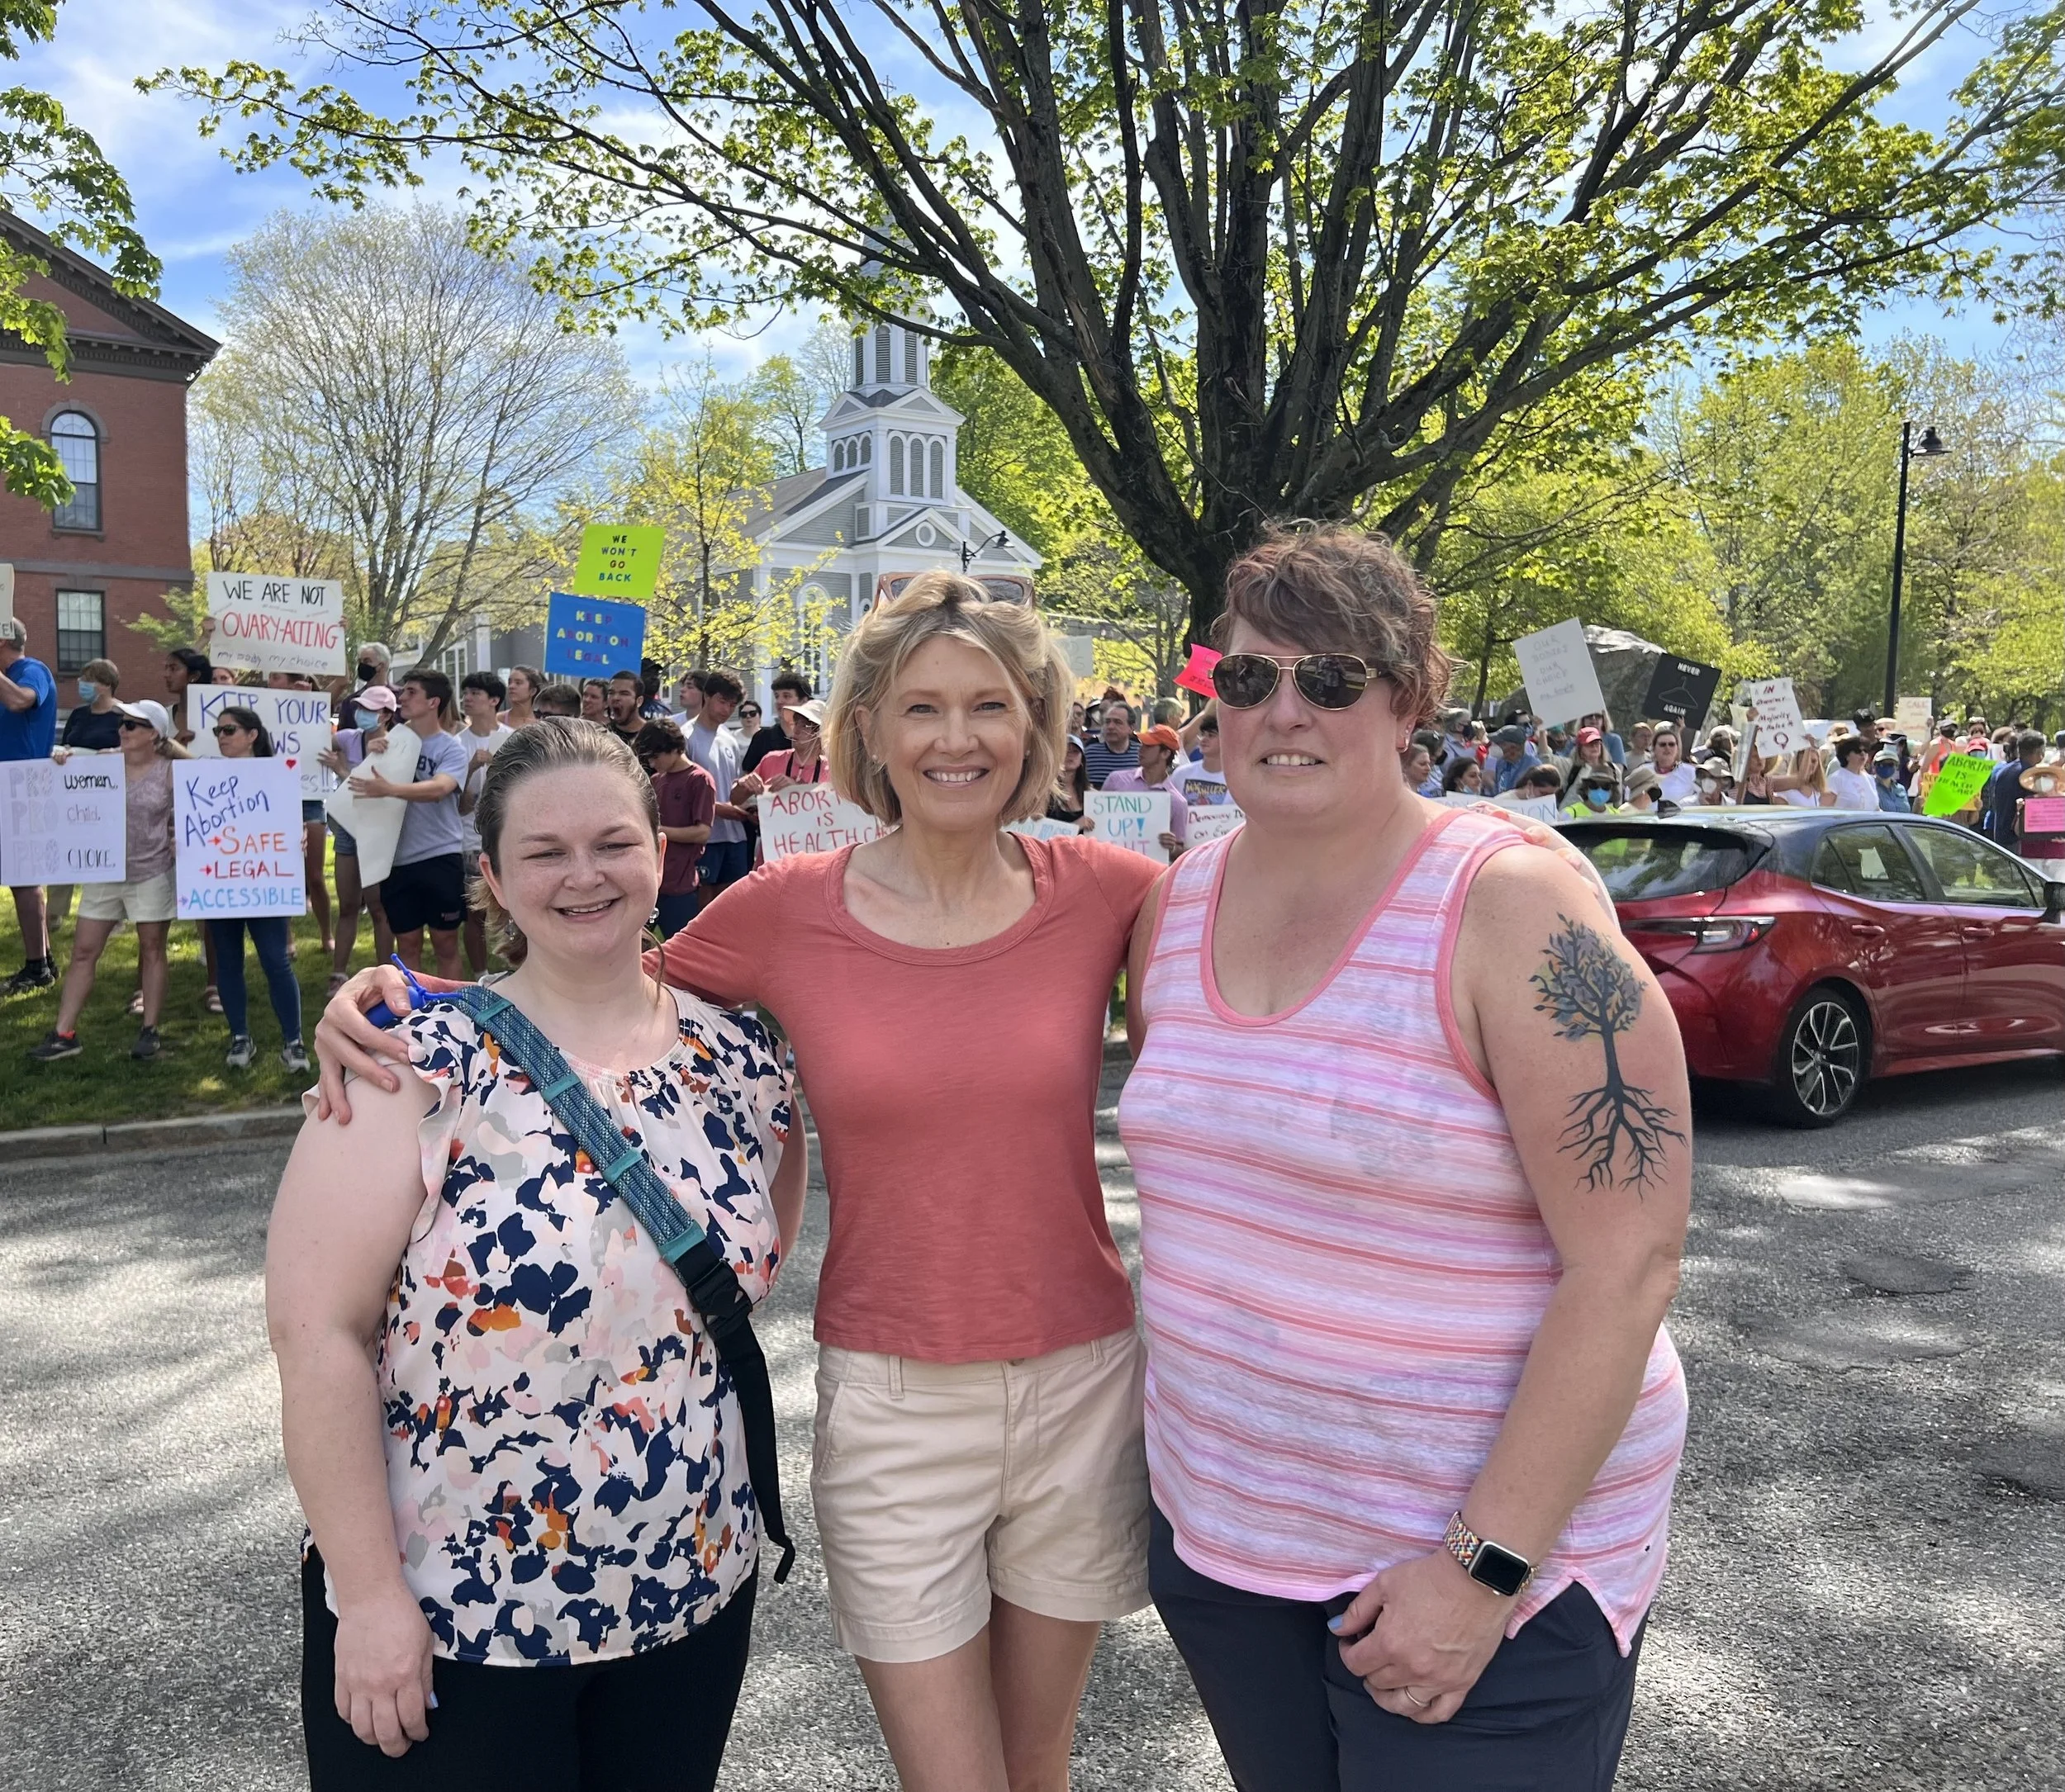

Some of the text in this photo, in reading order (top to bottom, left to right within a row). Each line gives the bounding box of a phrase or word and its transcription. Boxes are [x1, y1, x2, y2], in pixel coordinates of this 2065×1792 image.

[612, 535, 628, 544] WE
[601, 547, 638, 557] WON'T
[610, 560, 625, 569] GO
[598, 572, 631, 582] BACK
[222, 580, 326, 607] WE ARE NOT
[576, 609, 613, 625] KEEP
[222, 611, 339, 650] OVARY-ACTING
[556, 627, 629, 647] ABORTION
[567, 648, 610, 665] LEGAL
[1677, 661, 1701, 676] NEVER
[274, 697, 327, 725] YOUR
[186, 775, 239, 812] Keep
[1093, 795, 1152, 815] STAND
[185, 789, 270, 847] Abortion
[817, 812, 834, 827] IS
[220, 825, 288, 856] SAFE
[213, 860, 295, 880] LEGAL
[188, 886, 305, 911] ACCESSIBLE
